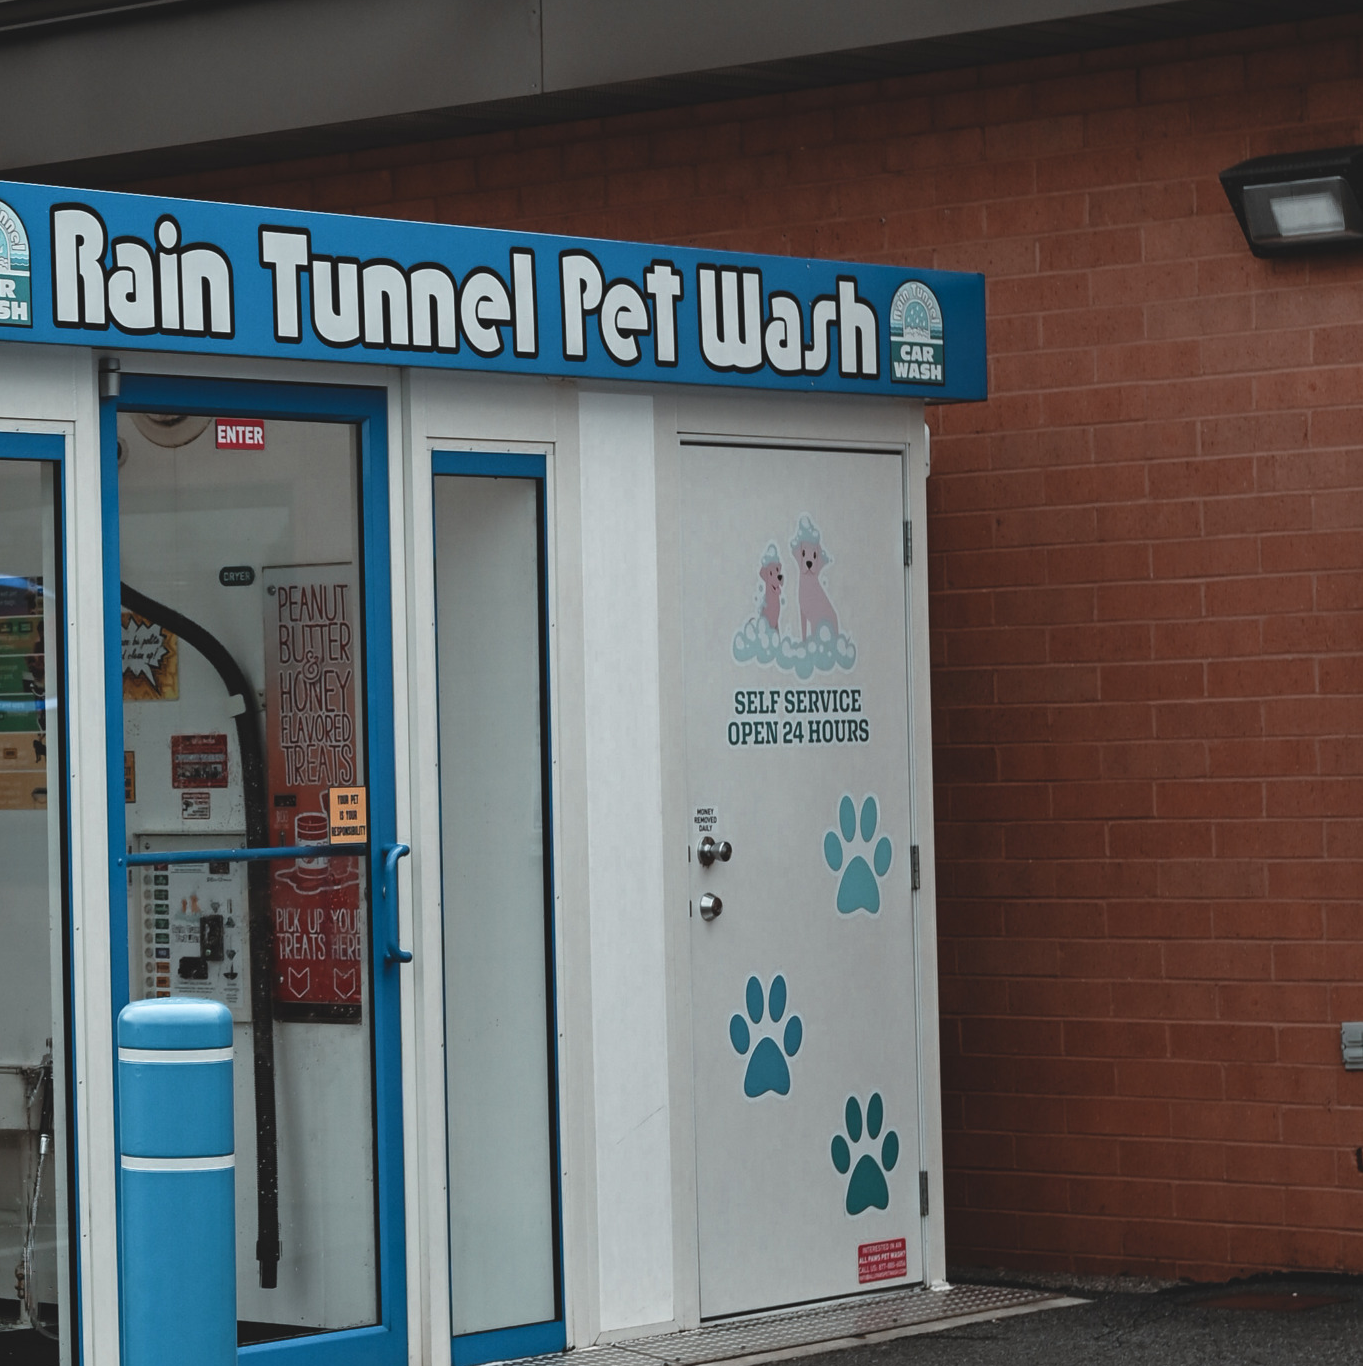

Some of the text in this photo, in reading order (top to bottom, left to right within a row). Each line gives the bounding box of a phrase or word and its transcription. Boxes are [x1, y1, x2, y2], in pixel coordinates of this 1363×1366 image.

[49, 201, 880, 380] Rain Tunnel Pet Wash
[900, 345, 934, 362] CAR
[894, 362, 941, 380] WASH
[217, 426, 263, 444] ENTER
[278, 584, 348, 623] PEANUT
[279, 622, 352, 664] BUTTER
[302, 650, 320, 681] &
[280, 670, 352, 714] HONEY
[735, 689, 861, 715] SELF SERVICE
[281, 714, 352, 744] FLAVORED
[728, 719, 869, 745] OPEN 24 HOURS
[281, 744, 353, 785] TREATS
[338, 795, 348, 804] YOUR
[697, 808, 714, 816] MONEY
[340, 810, 357, 820] IS YOUR
[694, 816, 717, 824] REMOVED
[699, 824, 712, 832] DAILY
[332, 826, 365, 836] RESPONSIBILITY
[276, 908, 301, 933] PICK
[308, 910, 324, 934] UP
[277, 934, 326, 960] TREATS
